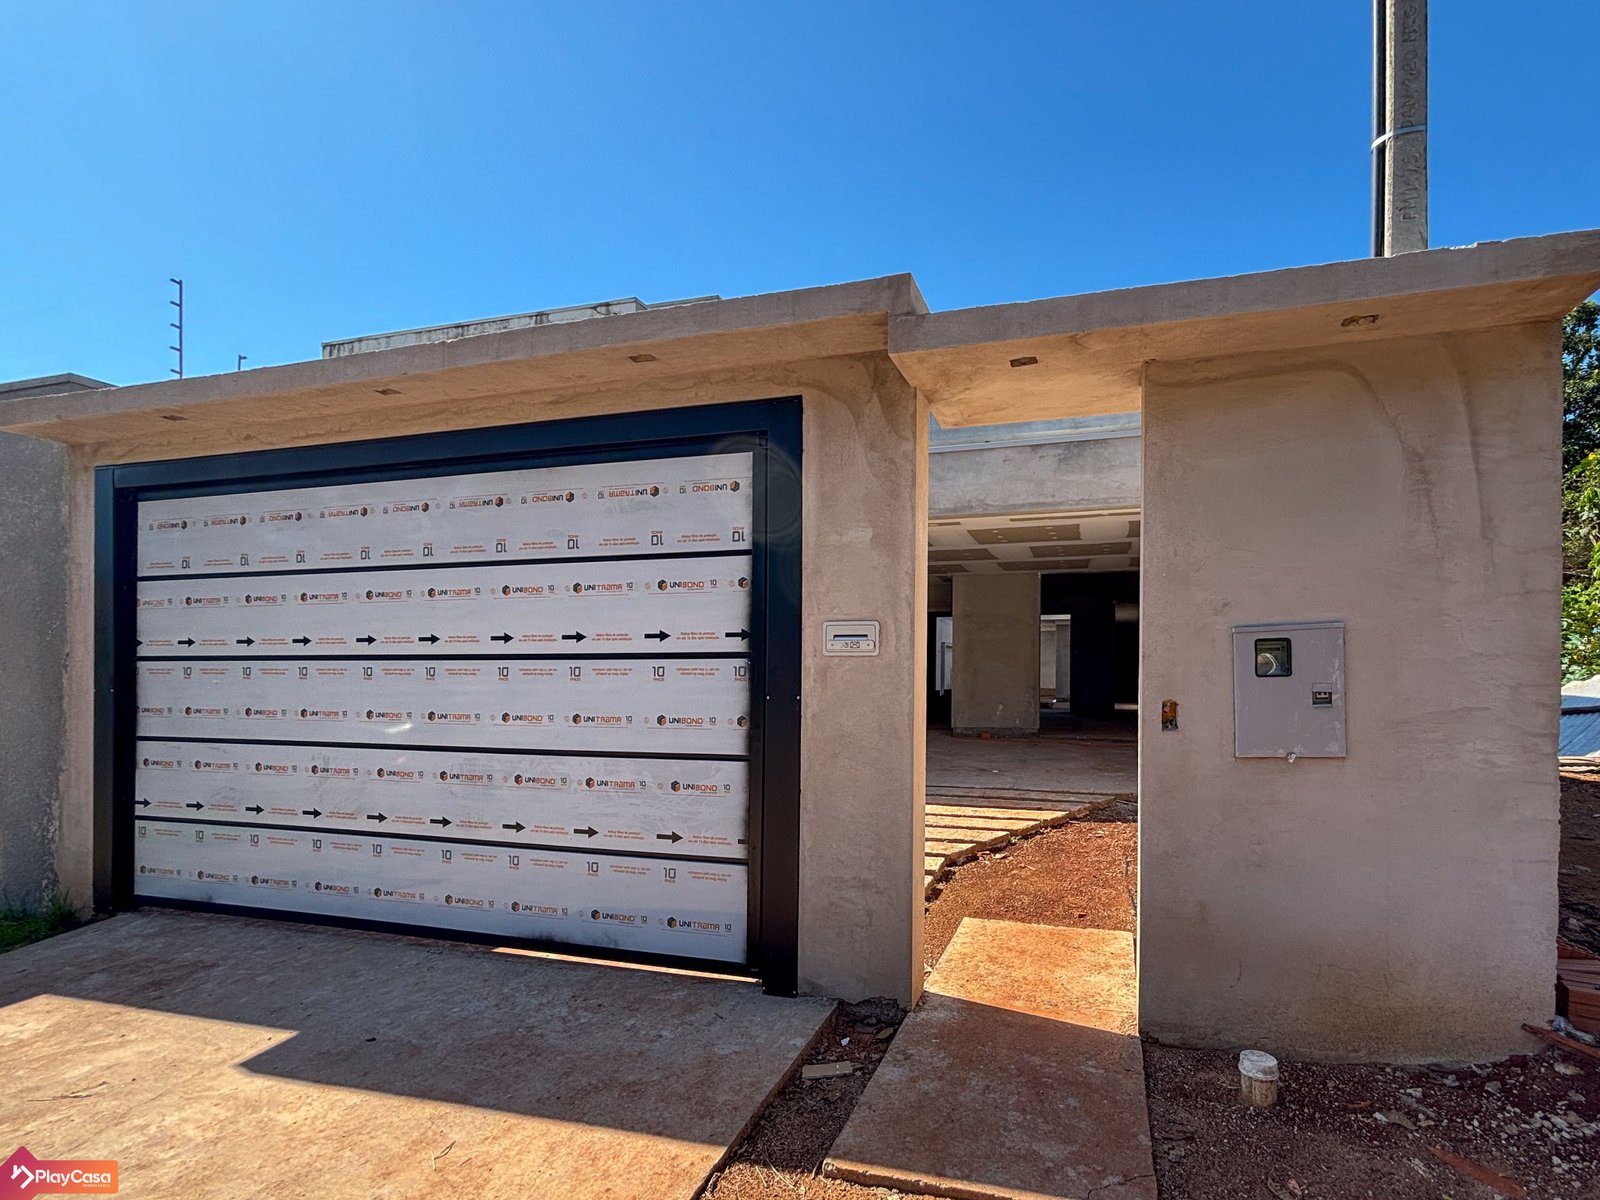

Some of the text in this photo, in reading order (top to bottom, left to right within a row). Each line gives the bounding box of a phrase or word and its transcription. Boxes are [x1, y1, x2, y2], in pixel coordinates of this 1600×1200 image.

[692, 483, 727, 492] UNIBOND
[651, 535, 663, 546] 10
[732, 531, 745, 542] 10
[496, 542, 507, 553] 10
[568, 539, 579, 549] 10
[569, 667, 581, 677] 10
[652, 666, 664, 677] 10
[734, 666, 746, 677] 10
[508, 855, 519, 866] 10
[587, 862, 598, 872] 10
[664, 868, 676, 879] 10
[602, 913, 635, 922] UNIBOND
